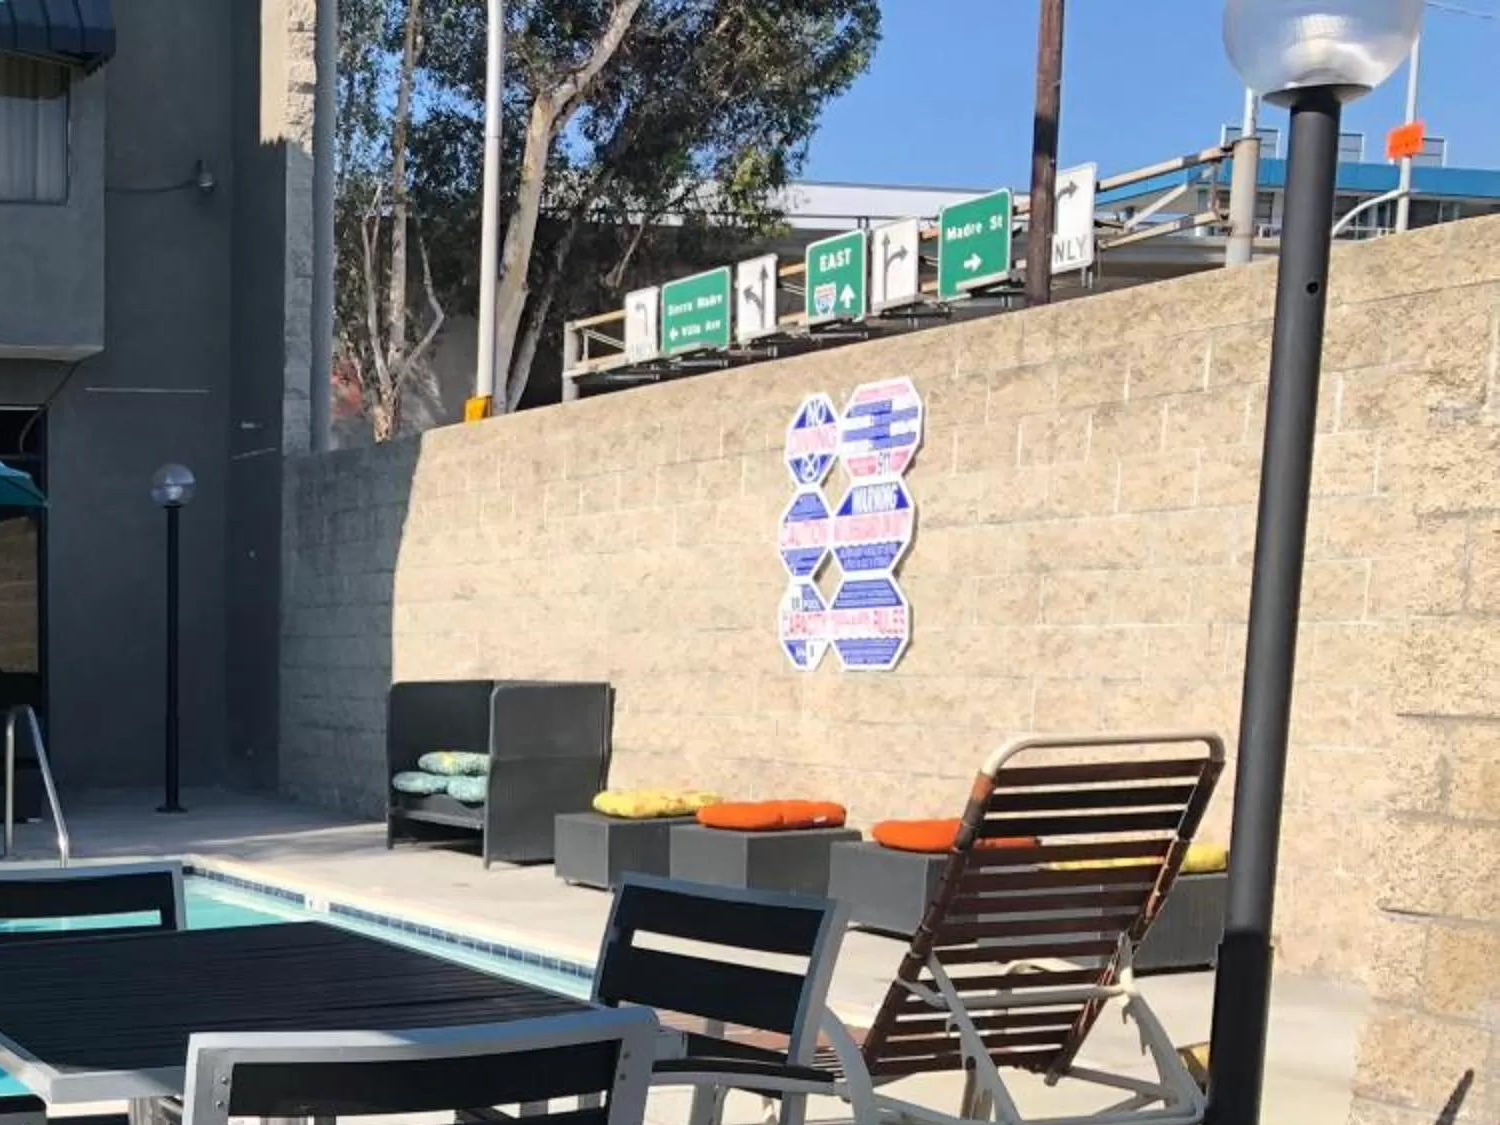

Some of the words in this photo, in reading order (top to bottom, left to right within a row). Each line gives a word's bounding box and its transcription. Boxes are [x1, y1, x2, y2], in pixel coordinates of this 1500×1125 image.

[946, 221, 983, 241] Madre
[989, 213, 1004, 231] St
[819, 247, 853, 272] EAST
[1052, 235, 1087, 265] NLY
[805, 398, 826, 428] NO
